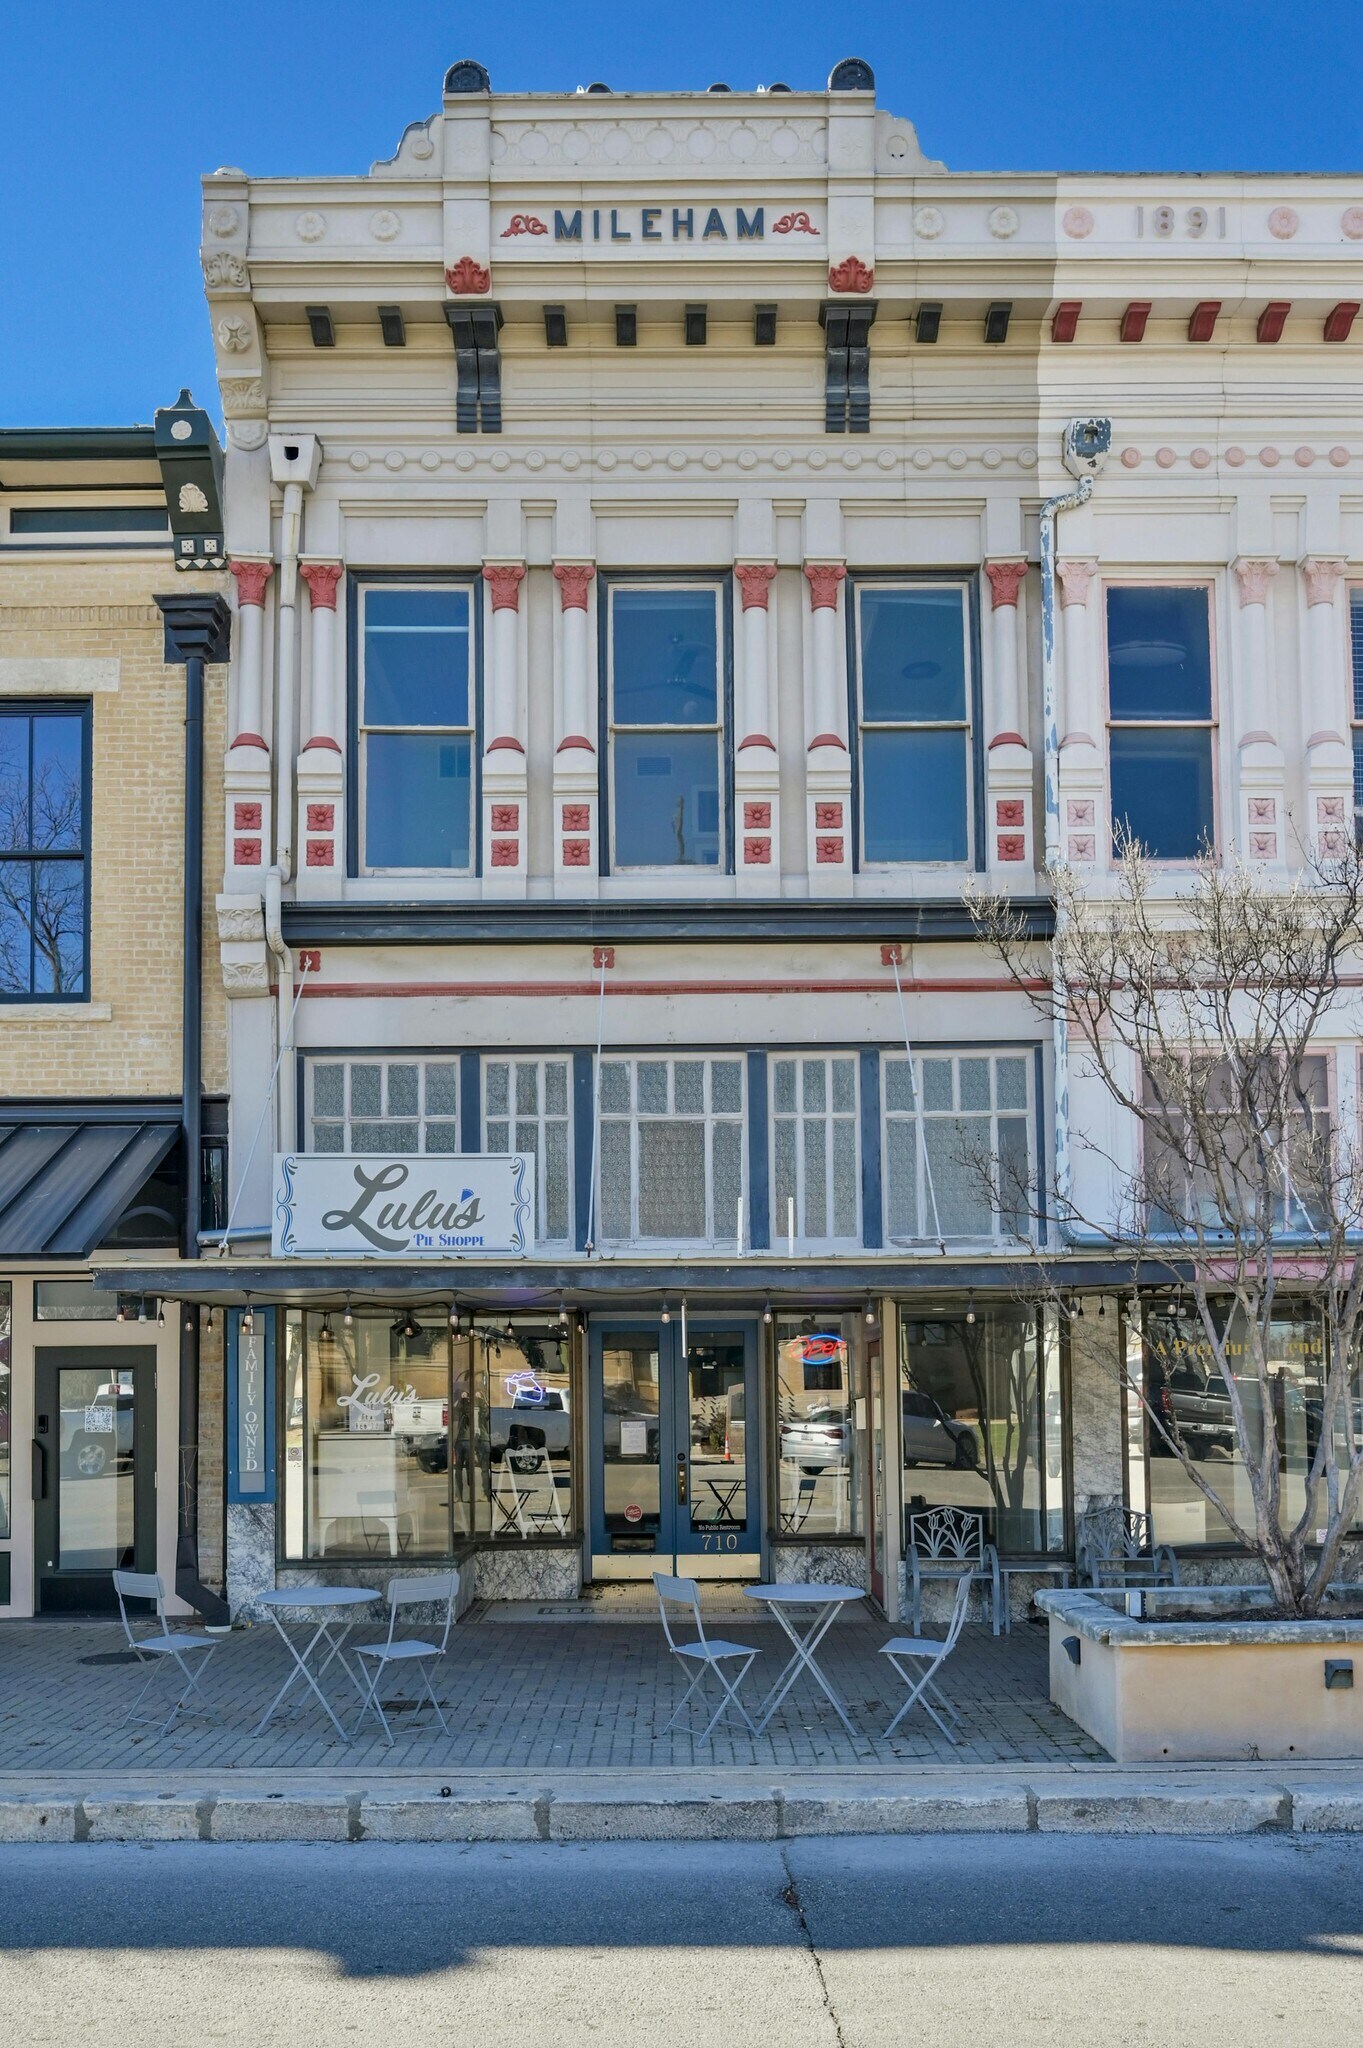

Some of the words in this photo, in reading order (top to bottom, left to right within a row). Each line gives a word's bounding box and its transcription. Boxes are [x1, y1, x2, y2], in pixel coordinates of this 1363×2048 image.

[554, 207, 765, 242] MILEHAM
[1134, 205, 1226, 239] 1891
[321, 1163, 486, 1252] Lulu's
[245, 1337, 258, 1406] FAMILY
[336, 1373, 420, 1417] Lulu's
[243, 1411, 259, 1471] OWNED
[701, 1534, 738, 1551] 710
